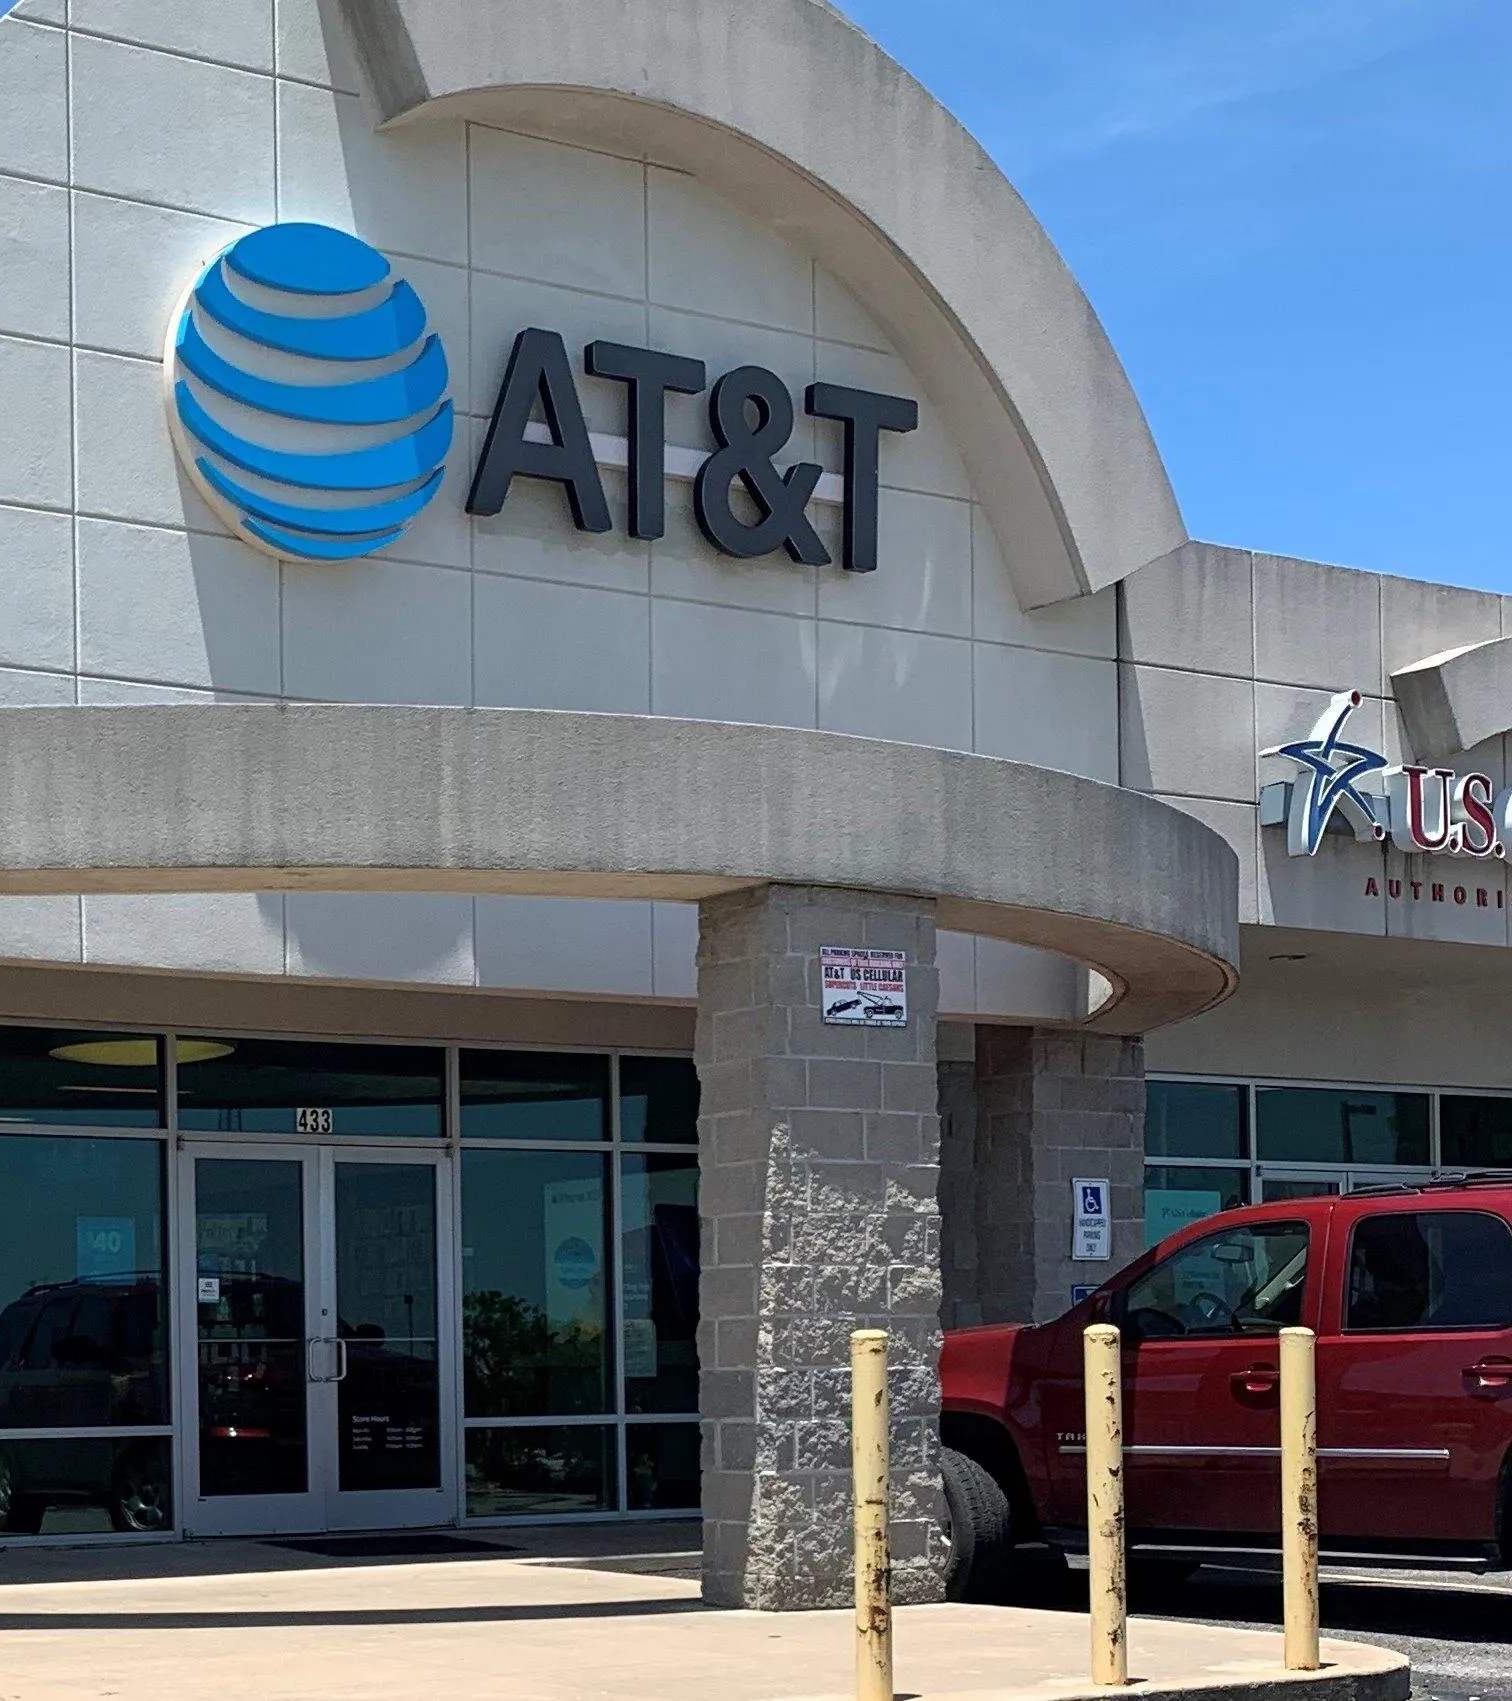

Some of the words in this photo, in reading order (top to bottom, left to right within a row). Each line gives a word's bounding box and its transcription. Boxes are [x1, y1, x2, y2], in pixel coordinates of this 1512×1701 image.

[465, 327, 919, 573] AT&T
[1385, 764, 1512, 859] U.S.
[1364, 876, 1504, 909] AUTHORI
[824, 967, 844, 979] AT&T
[850, 968, 861, 981] US
[863, 969, 904, 982] CELLULAR
[859, 982, 877, 991] LITTLE
[298, 1108, 330, 1132] 433
